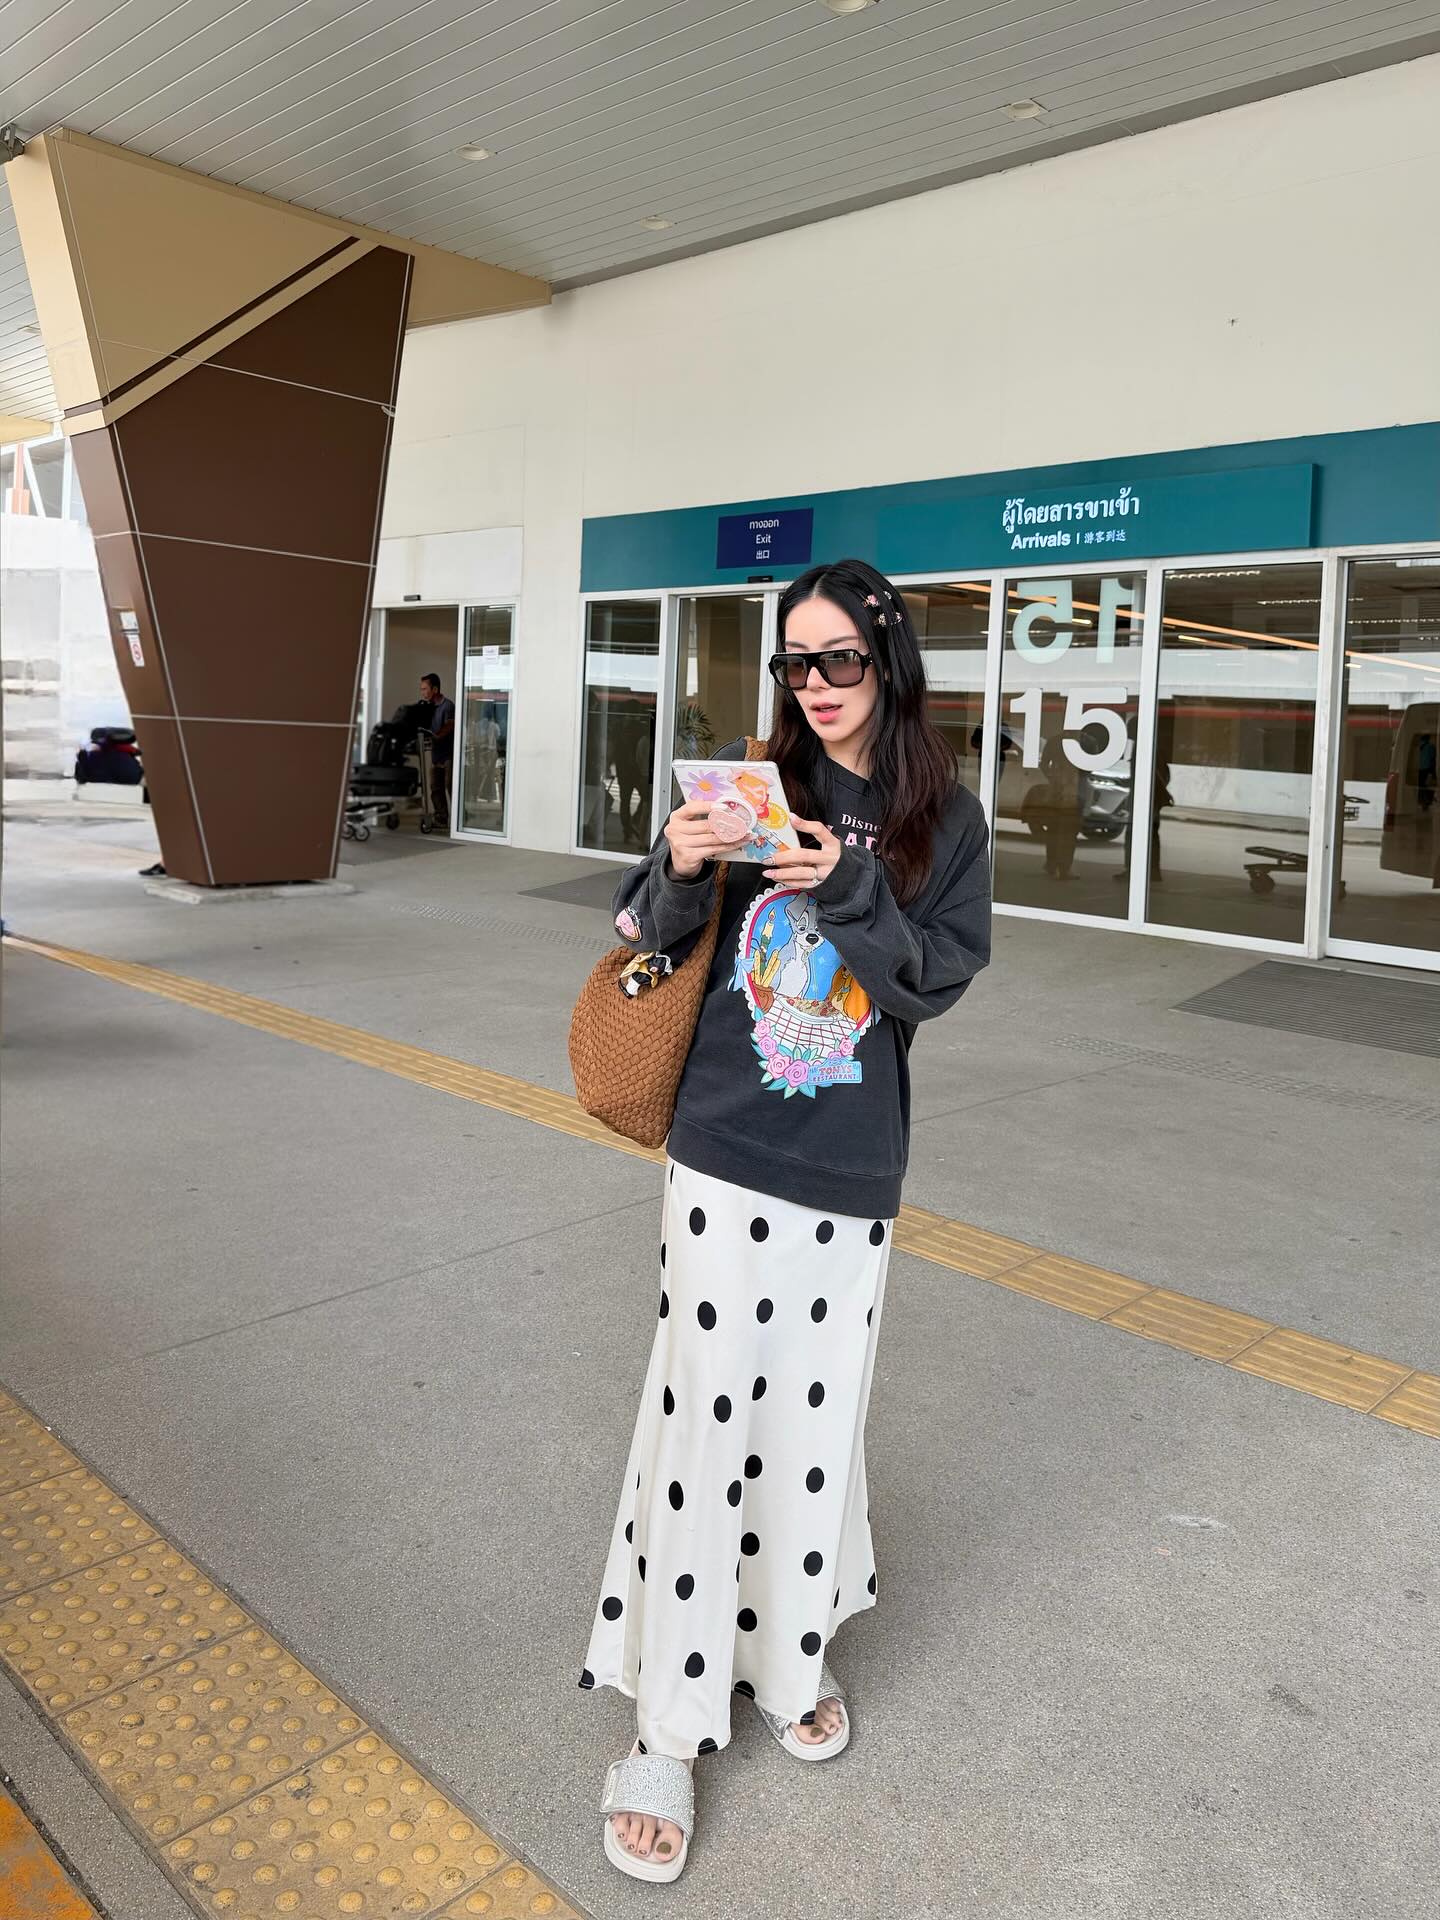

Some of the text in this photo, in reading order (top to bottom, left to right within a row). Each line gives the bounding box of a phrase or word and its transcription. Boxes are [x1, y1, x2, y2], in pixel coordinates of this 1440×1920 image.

[1002, 487, 1140, 533] ผู้โดยสารขาเข้า
[749, 519, 780, 530] ทางออก
[755, 533, 772, 545] Exit
[1011, 530, 1072, 550] Arrivals
[755, 549, 770, 560] 出口
[1009, 687, 1129, 772] 15
[840, 813, 882, 833] Disne
